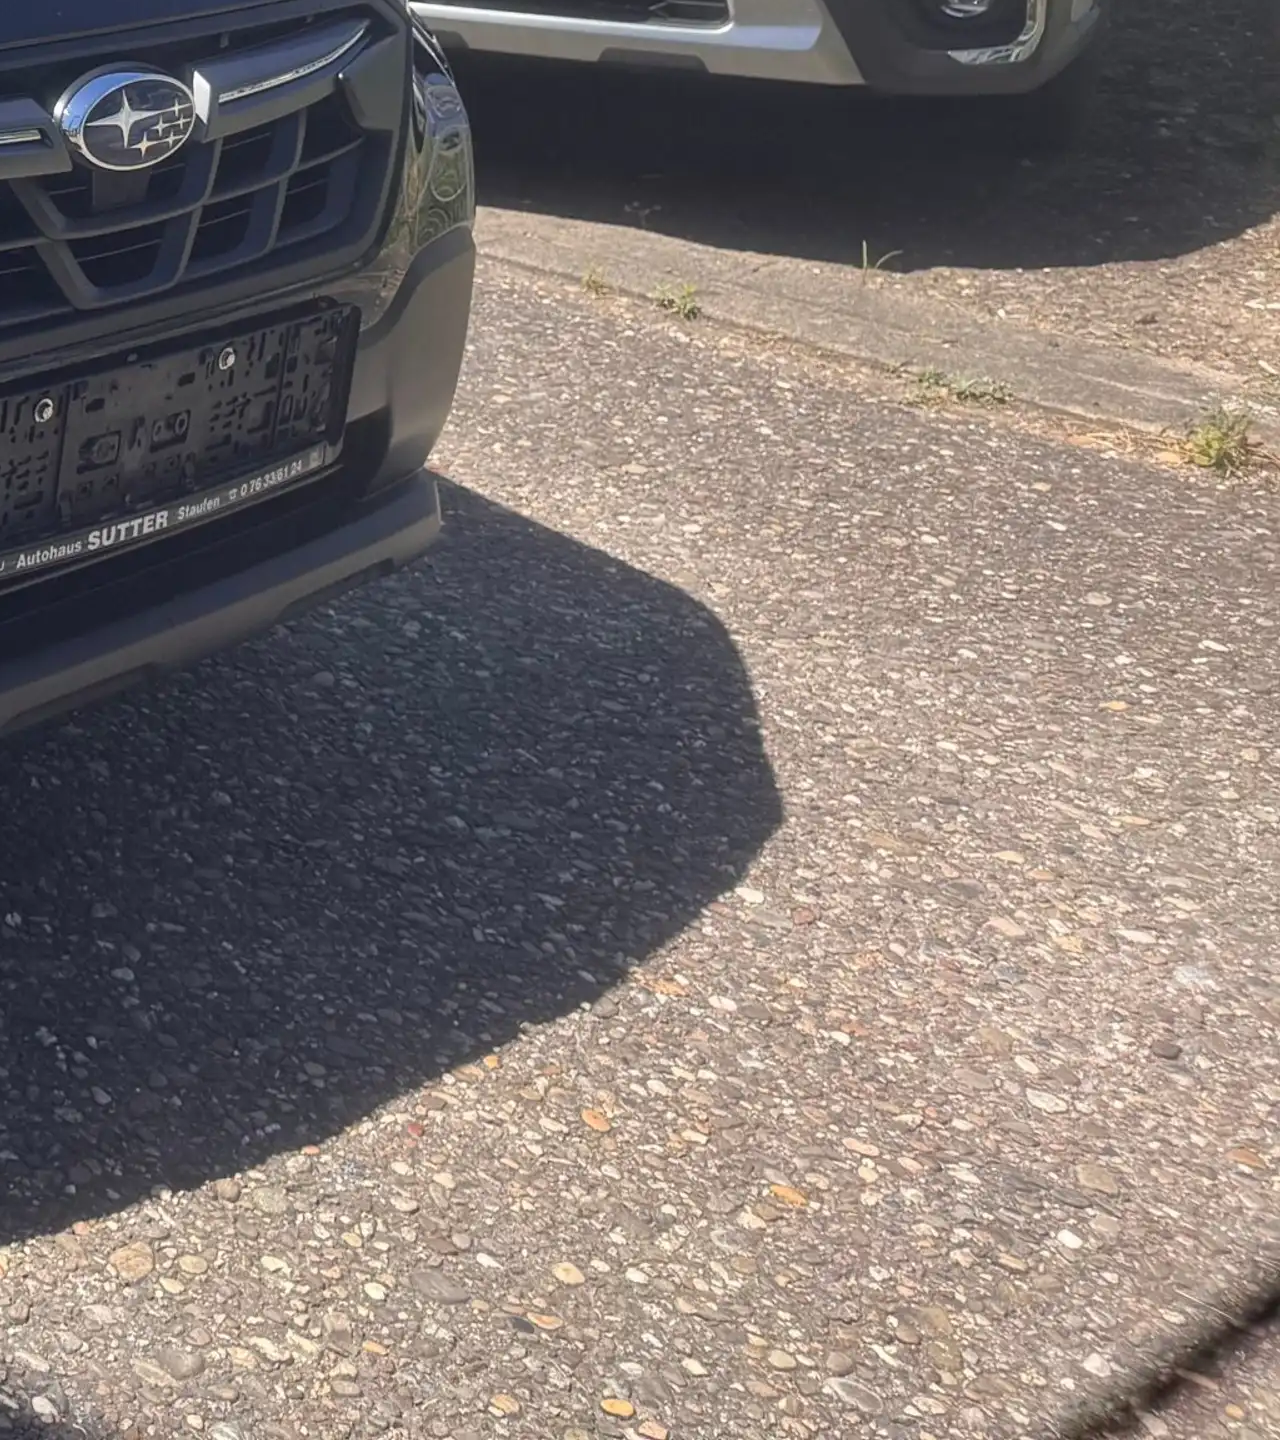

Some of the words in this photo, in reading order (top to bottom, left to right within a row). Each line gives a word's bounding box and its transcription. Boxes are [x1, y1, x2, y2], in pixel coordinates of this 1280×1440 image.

[16, 541, 82, 569] Autohaus
[87, 511, 168, 551] SUTTER
[178, 497, 220, 520] Staufen
